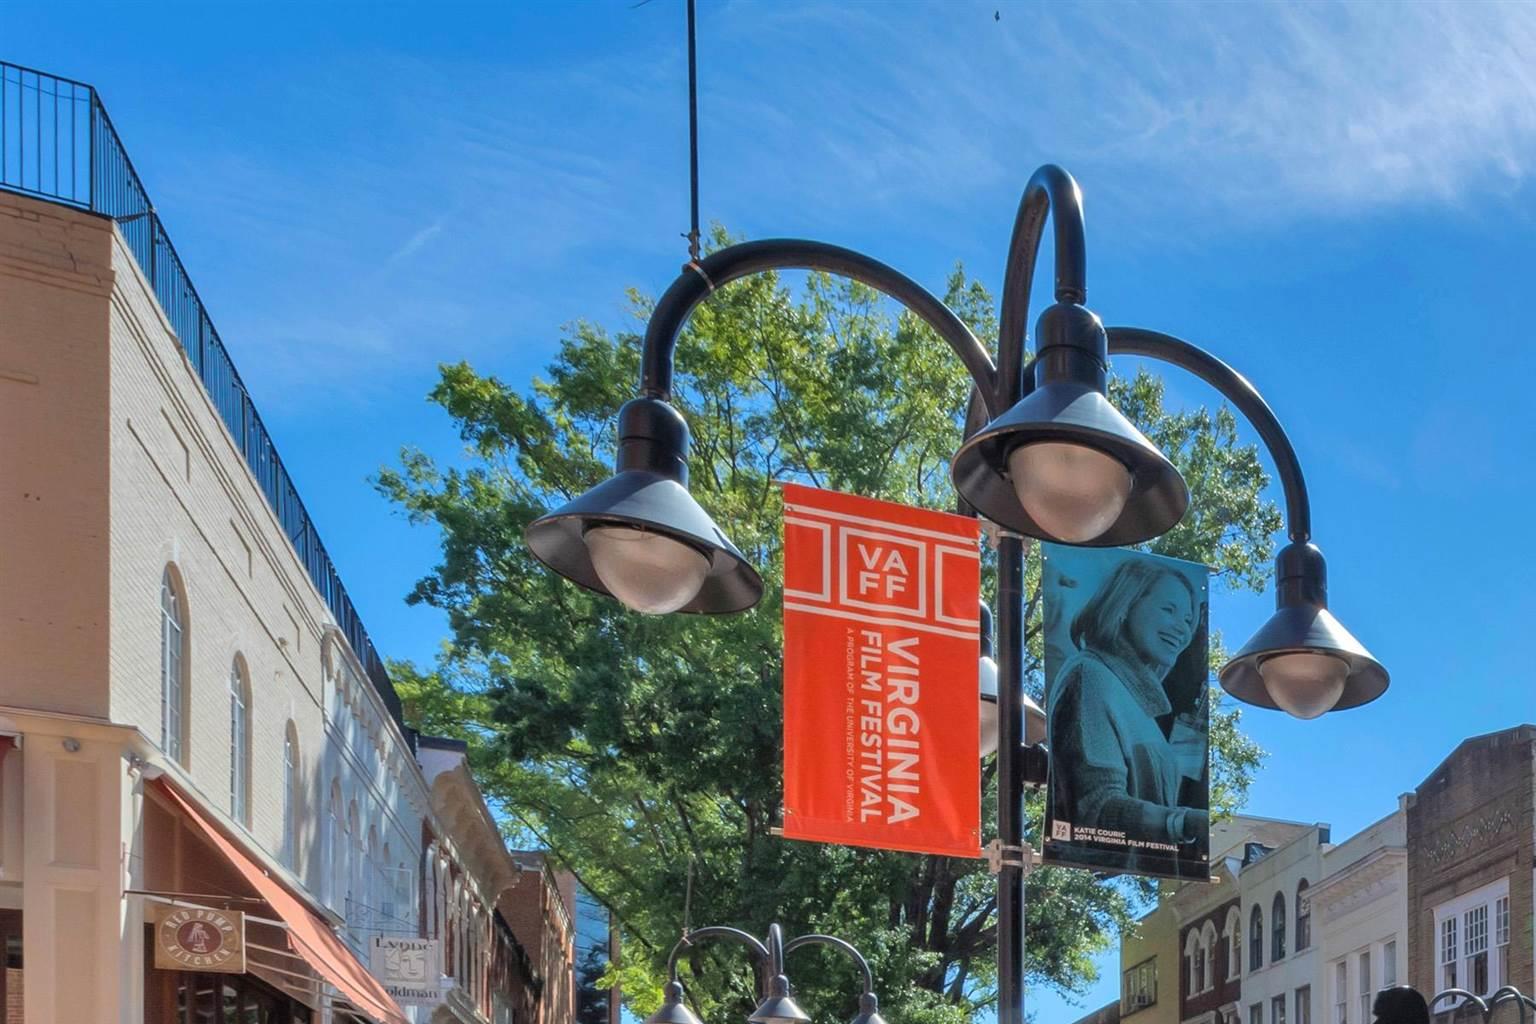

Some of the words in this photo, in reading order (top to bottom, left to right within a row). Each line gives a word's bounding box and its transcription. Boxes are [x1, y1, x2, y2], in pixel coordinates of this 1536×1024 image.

[857, 543, 909, 575] VA
[859, 571, 907, 599] FF
[846, 635, 854, 681] PROGRAM
[861, 629, 882, 692] FILM
[846, 682, 854, 695] OF
[846, 697, 854, 714] THE
[846, 715, 854, 766] UNIVERSITY
[887, 636, 920, 825] VIRGINIA
[861, 699, 882, 824] FESTIVAL
[846, 769, 854, 782] OF
[846, 784, 854, 823] VIRGINIA
[1074, 826, 1096, 835] KATIE
[1097, 829, 1126, 839] COURIC
[1074, 833, 1092, 841] 2014
[1093, 835, 1126, 846] VIRGINIA
[1128, 840, 1145, 848] FILM
[1146, 842, 1180, 852] FESTIVAL
[165, 911, 190, 929] RED
[196, 910, 233, 931] PUMP
[167, 944, 231, 965] KITCHEN
[384, 986, 438, 999] oldman
